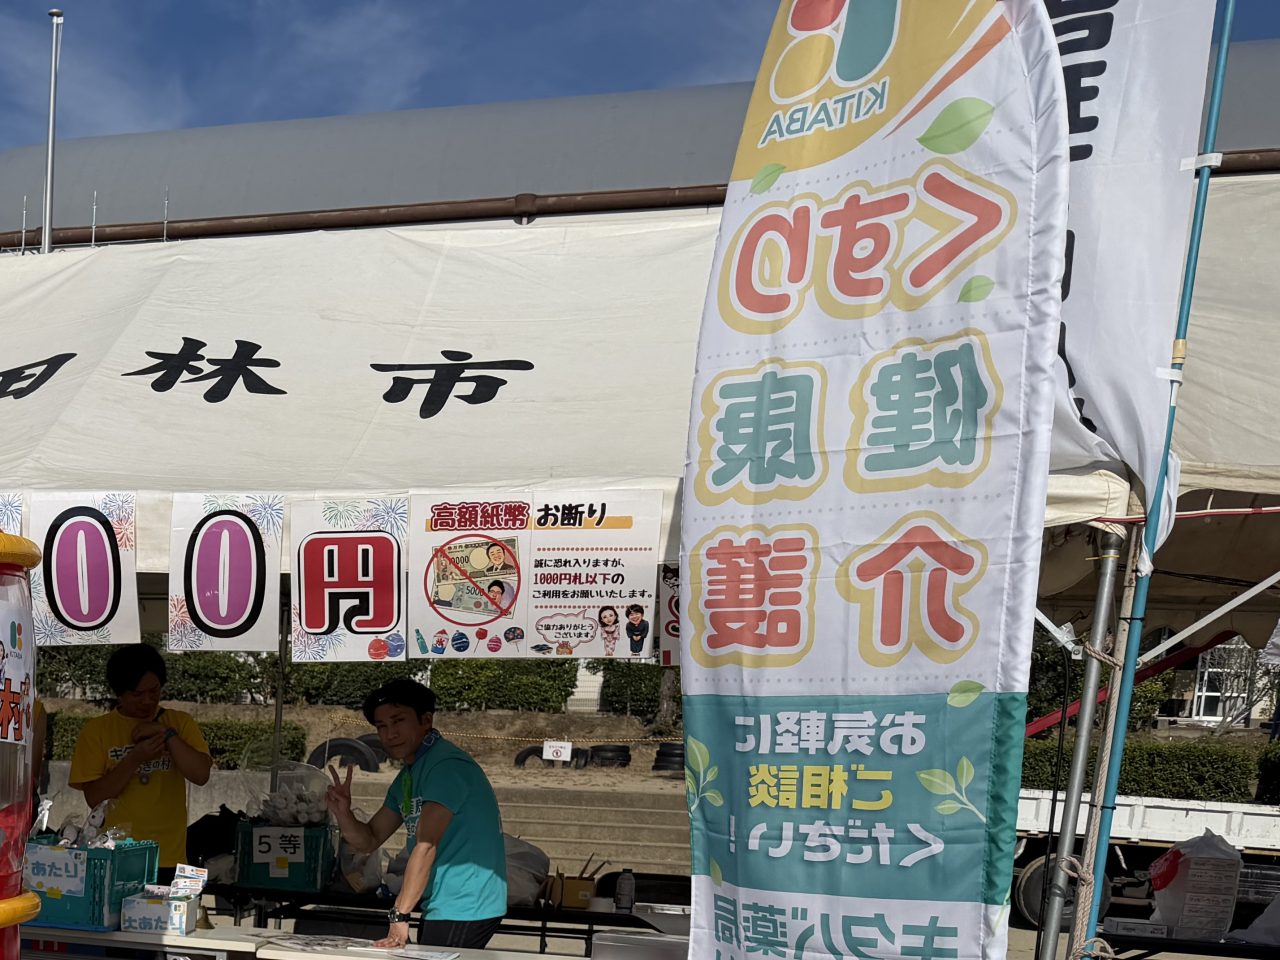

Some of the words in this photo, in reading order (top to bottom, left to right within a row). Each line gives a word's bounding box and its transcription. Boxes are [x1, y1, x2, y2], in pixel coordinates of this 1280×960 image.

[431, 501, 530, 531] 高額紙幣
[536, 502, 607, 528] お断り
[533, 558, 626, 569] 誠に恐れ入りますが、
[533, 573, 625, 586] 1000円札以下の
[532, 588, 653, 600] ご利用をお願いいたします。
[257, 833, 301, 855] 5等
[31, 860, 78, 879] あたり
